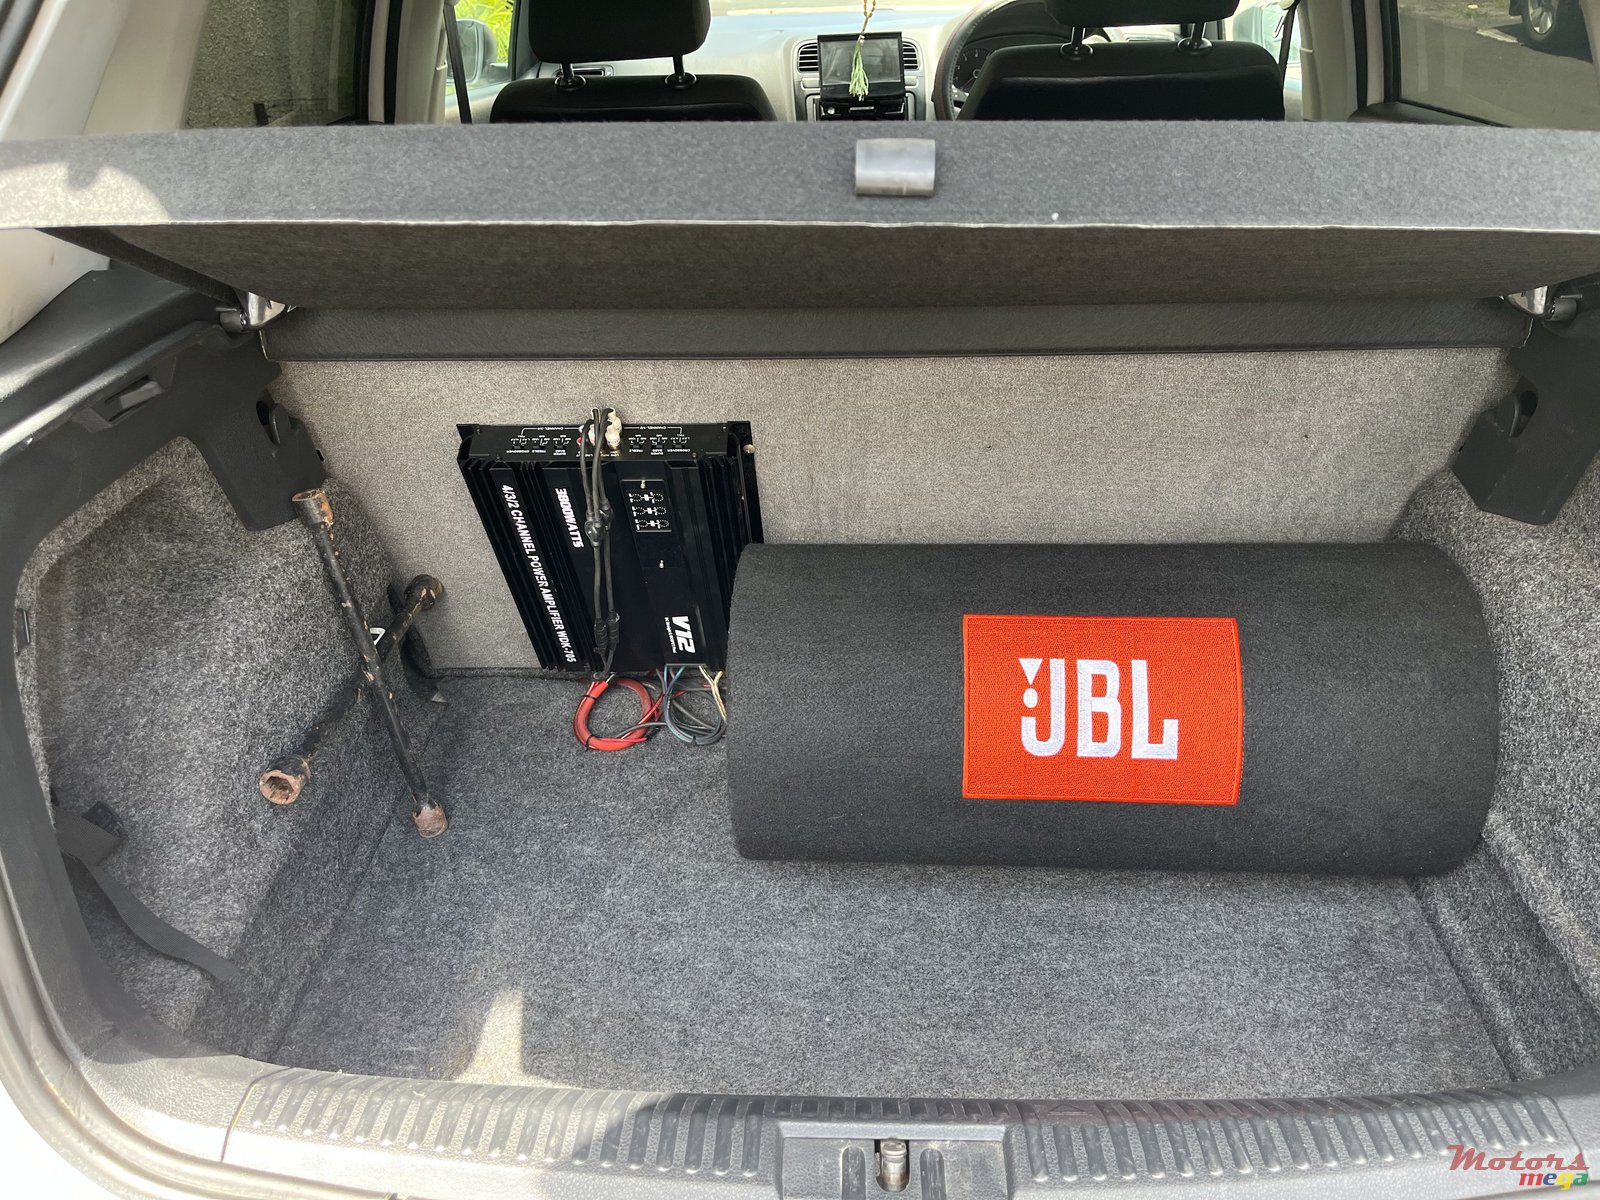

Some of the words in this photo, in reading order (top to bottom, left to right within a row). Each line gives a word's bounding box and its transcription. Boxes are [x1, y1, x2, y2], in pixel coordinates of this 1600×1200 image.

[501, 484, 520, 509] 4/3/2
[510, 509, 536, 555] CHANNEL
[555, 487, 585, 549] 3800WATTS
[527, 554, 549, 588] POWER
[540, 586, 565, 631] AMPLIFIER
[556, 628, 577, 663] WDK-705
[671, 615, 696, 654] V12
[1018, 657, 1179, 760] JBL
